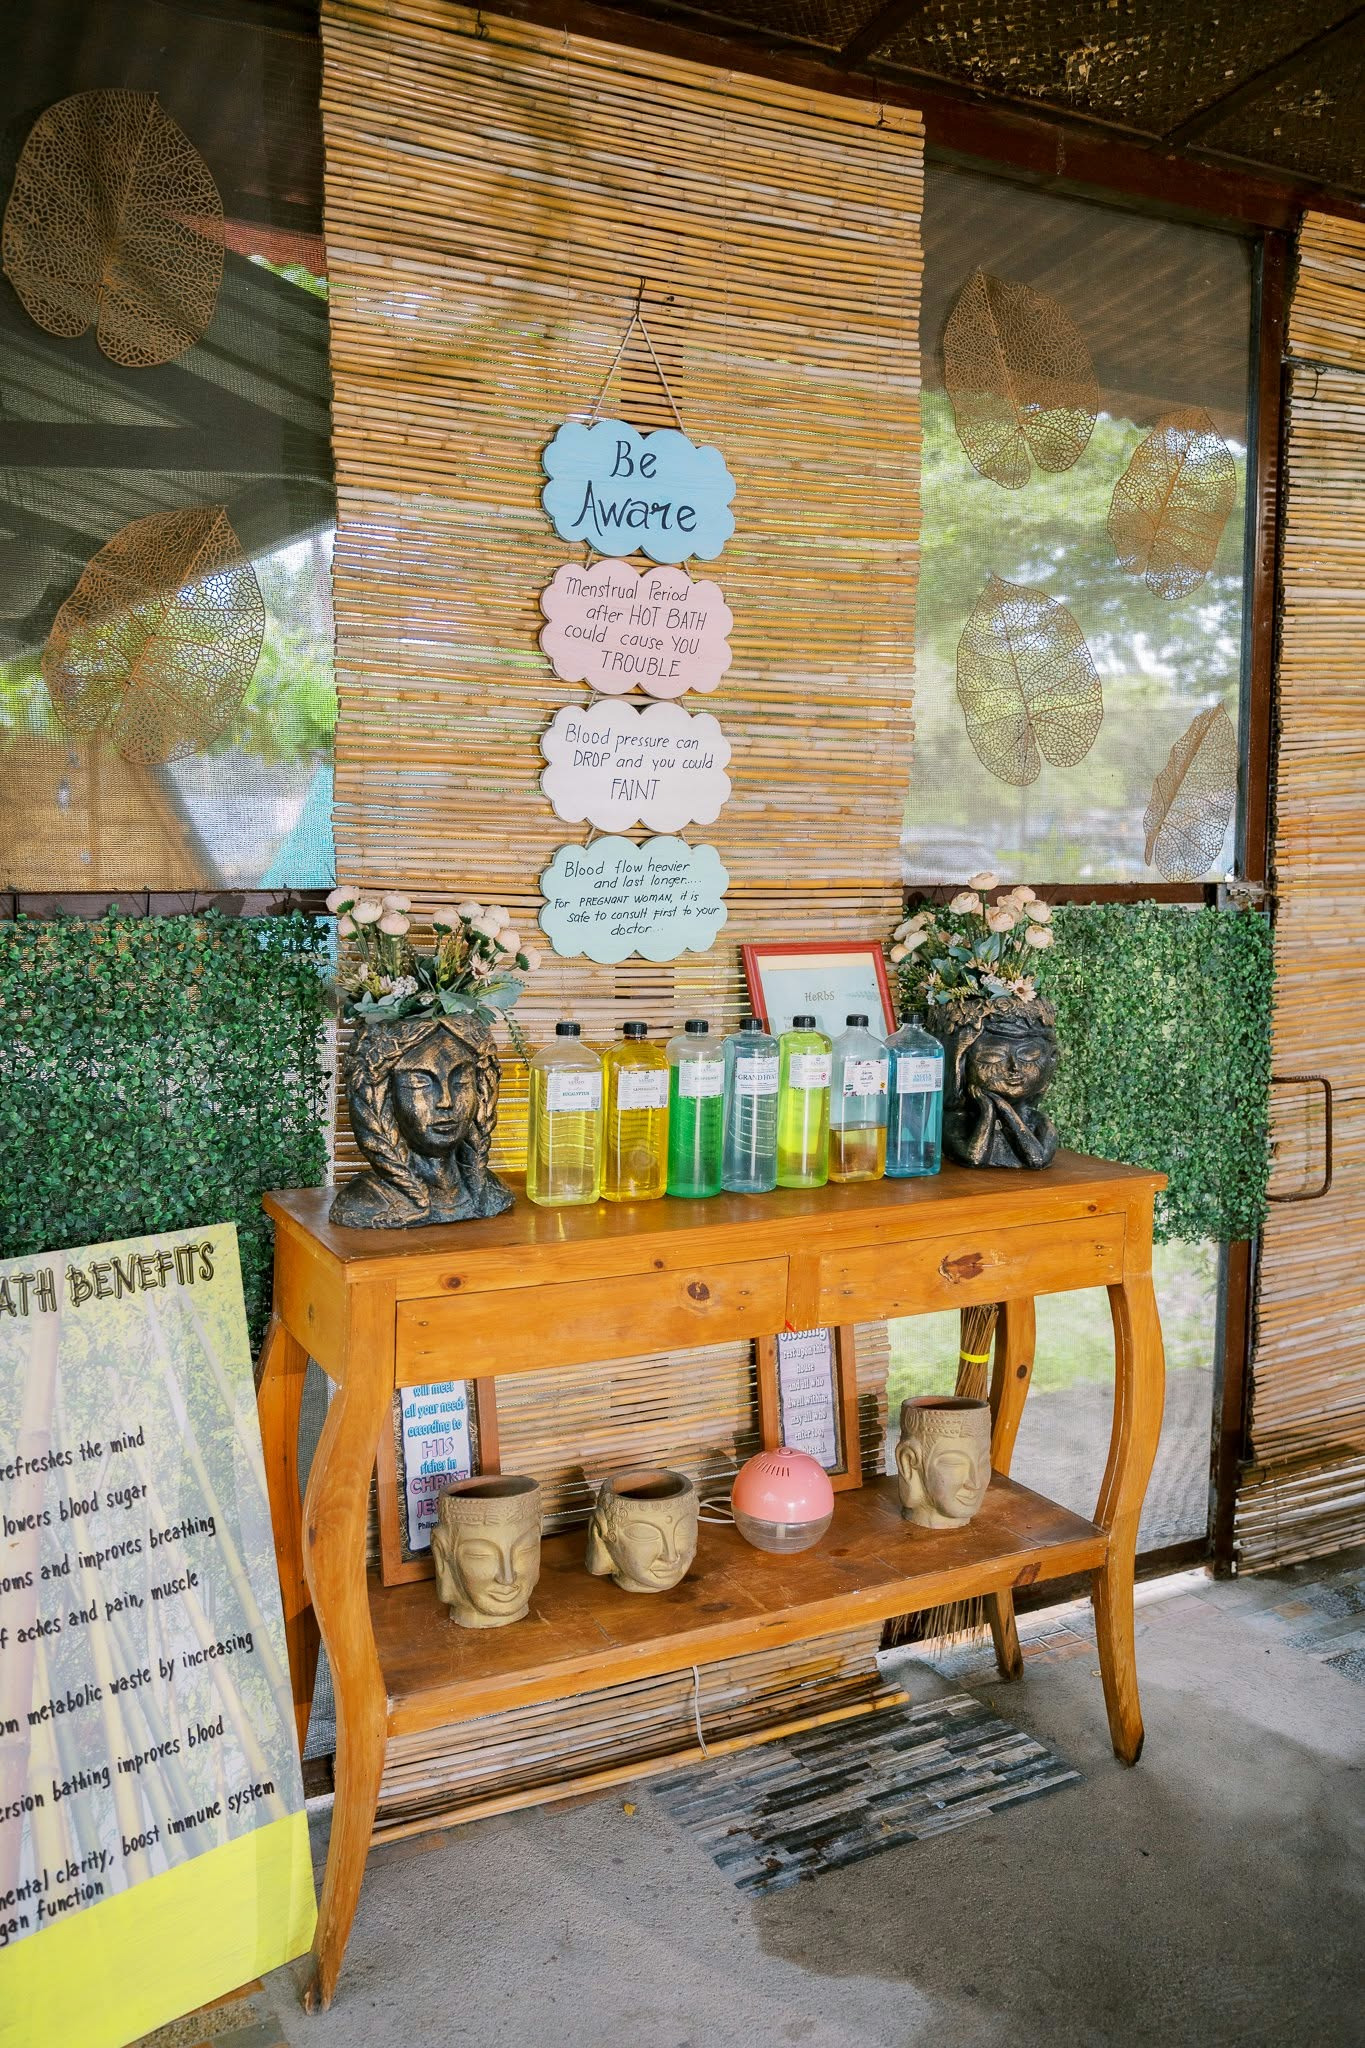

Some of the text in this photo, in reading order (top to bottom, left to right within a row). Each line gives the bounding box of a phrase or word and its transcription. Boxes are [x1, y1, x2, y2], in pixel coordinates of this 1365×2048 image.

[609, 440, 657, 479] Be
[571, 480, 697, 537] Aware
[566, 576, 690, 602] Menstrual Period
[586, 604, 707, 631] after HOT BATH
[564, 624, 699, 655] could cause YOU
[601, 650, 681, 677] TROUBLE
[565, 723, 699, 753] Blood pressure can
[573, 750, 714, 770] DROP and you could
[611, 778, 661, 801] FAINT
[564, 856, 690, 878] Blood flow heavier
[594, 876, 619, 889] and
[622, 874, 644, 888] last
[554, 898, 570, 909] For
[680, 890, 689, 901] it
[690, 891, 699, 901] is
[566, 911, 590, 923] safe
[595, 910, 607, 921] to
[611, 907, 647, 920] consult
[683, 904, 692, 916] to
[696, 906, 721, 918] your
[65, 1241, 214, 1307] BENEFITS
[413, 1380, 455, 1398] will meet
[404, 1396, 465, 1420] all your needs
[407, 1417, 463, 1438] according to
[0, 1426, 145, 1481] refreshes the mind
[422, 1437, 455, 1460] HIS
[420, 1457, 457, 1475] riches in
[3, 1484, 147, 1537] lowers blood sugar
[41, 1553, 70, 1580] and
[78, 1537, 142, 1570] improves
[149, 1516, 216, 1549] breathing
[17, 1617, 61, 1643] aches
[69, 1599, 98, 1626] and
[105, 1591, 144, 1621] pain,
[151, 1569, 199, 1601] muscle
[27, 1684, 102, 1726] metabolic
[109, 1667, 152, 1695] waste
[159, 1658, 175, 1681] by
[183, 1632, 254, 1668] increasing
[52, 1767, 111, 1802] bathing
[117, 1738, 180, 1774] improves
[187, 1715, 225, 1748] blood
[56, 1848, 114, 1886] clarity,
[122, 1824, 160, 1856] boost
[167, 1800, 221, 1835] immune
[227, 1781, 275, 1814] system
[37, 1881, 104, 1921] function
